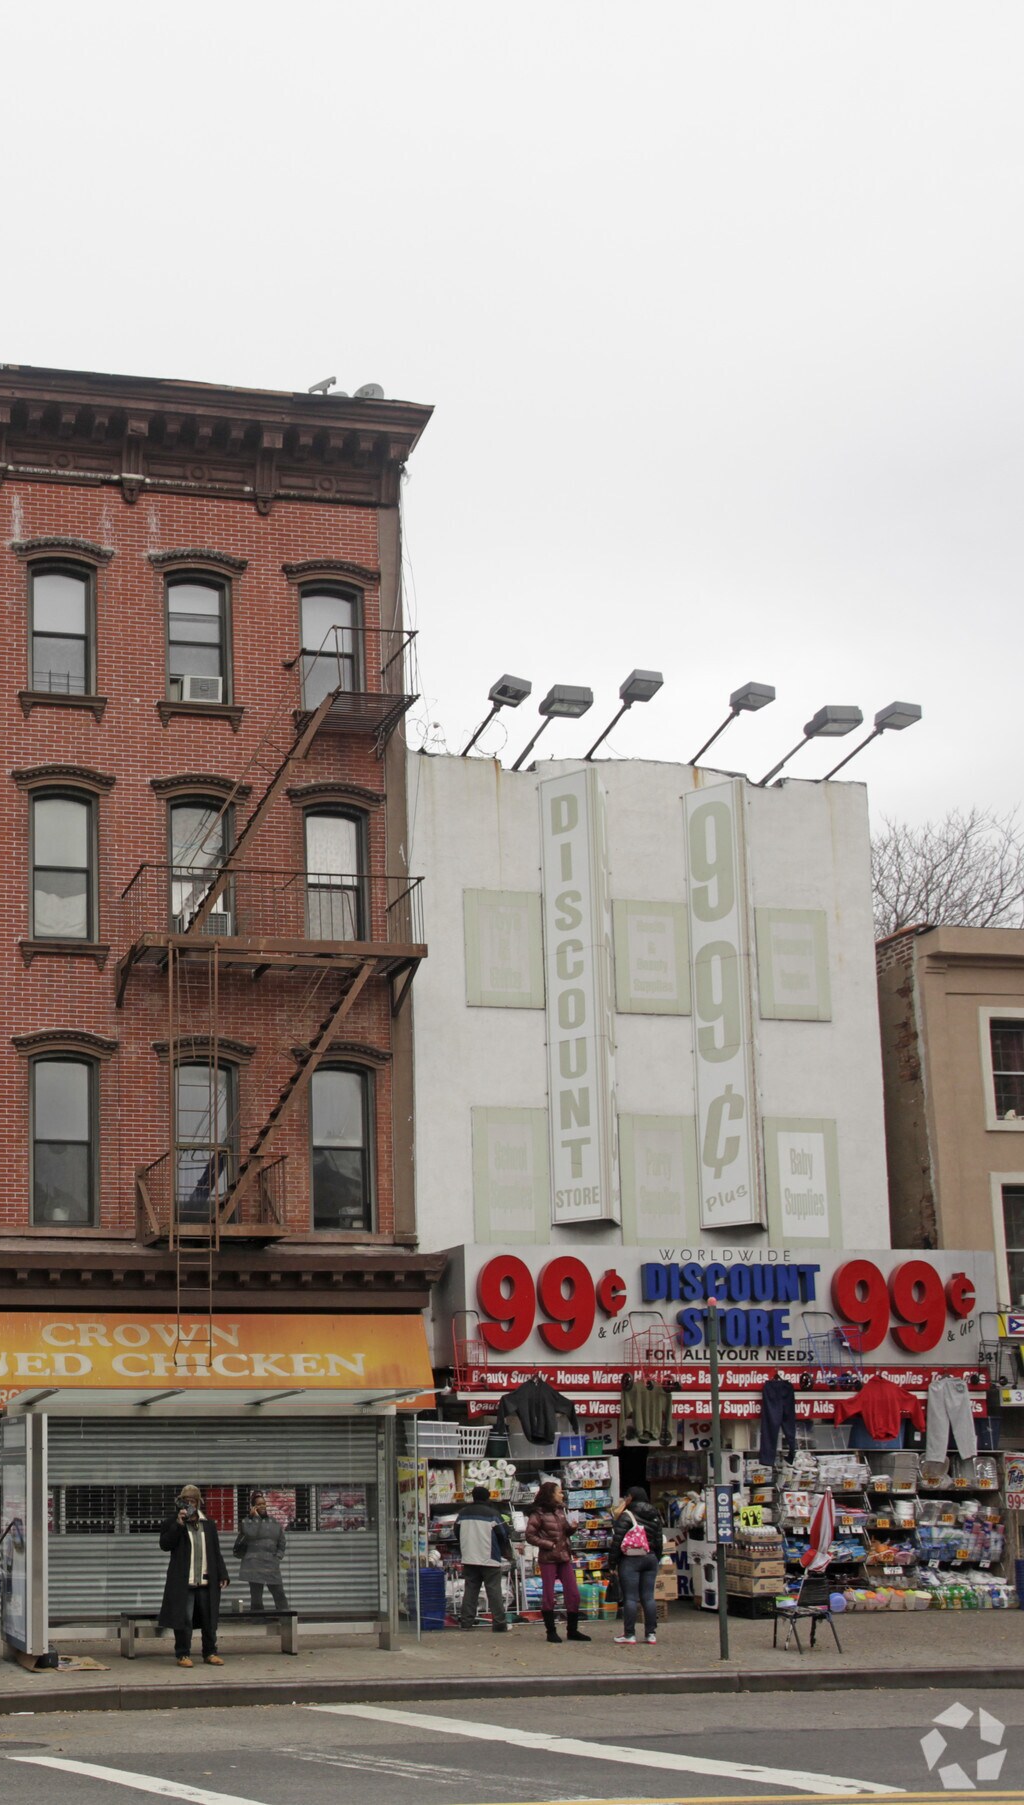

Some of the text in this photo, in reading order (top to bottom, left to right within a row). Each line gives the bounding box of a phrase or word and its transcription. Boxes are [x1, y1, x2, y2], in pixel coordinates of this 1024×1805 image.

[550, 793, 592, 1180] DISCOUNT
[790, 1147, 814, 1180] Baby
[555, 1186, 600, 1208] STORE
[784, 1186, 825, 1219] Supplies
[658, 1248, 791, 1262] WORLDWIDE
[641, 1262, 821, 1302] DISCOUNT
[477, 1254, 627, 1351] 99¢
[831, 1259, 976, 1353] 99¢
[41, 1322, 241, 1348] CROWN
[612, 1319, 630, 1335] UP
[677, 1307, 792, 1347] STORE
[959, 1319, 975, 1336] UP
[645, 1349, 815, 1362] FOR ALL YOUR NEEDS
[978, 1352, 998, 1362] 341
[112, 1352, 366, 1378] CHICKEN
[556, 1370, 589, 1384] House
[591, 1370, 624, 1384] Wares
[698, 1370, 724, 1387] Bay
[726, 1370, 769, 1387] Supplies
[880, 1370, 923, 1387] Supplies
[589, 1401, 621, 1414] Wares
[724, 1401, 762, 1417] Supplie
[813, 1401, 835, 1414] Aids
[1007, 1469, 1023, 1486] Tide
[742, 1510, 761, 1527] 99¢
